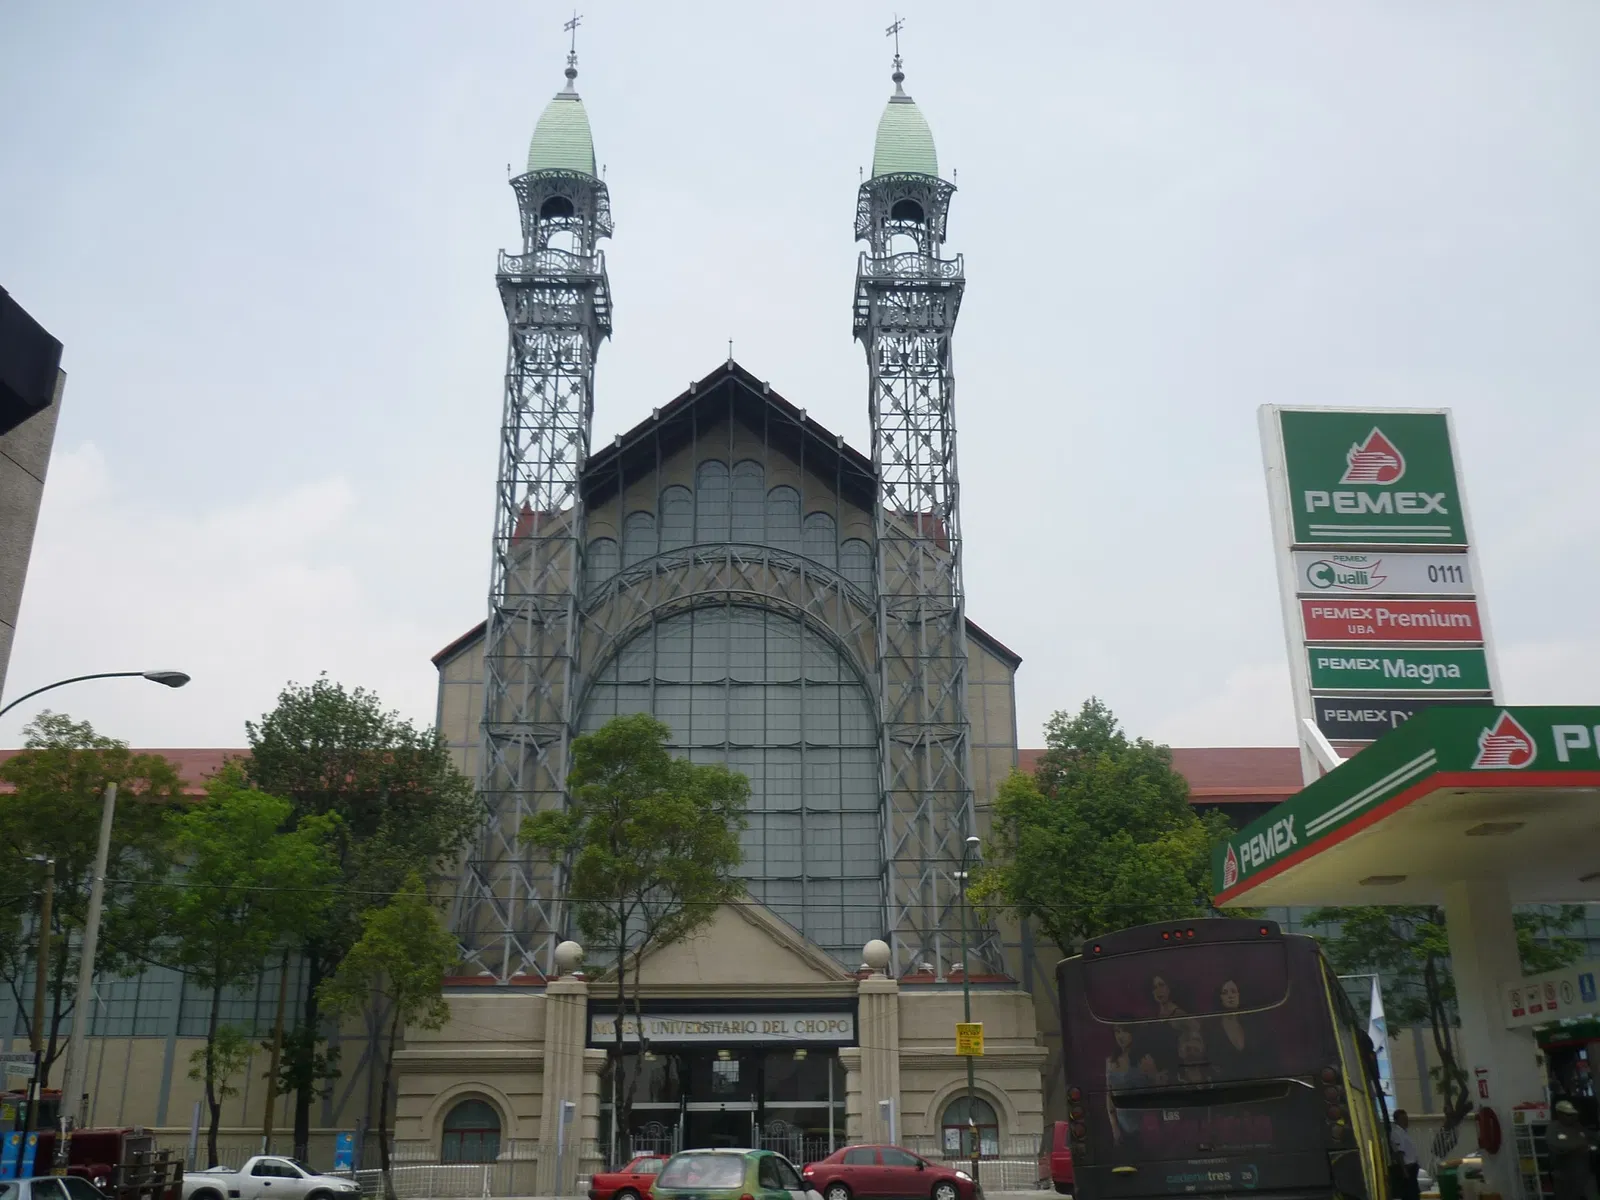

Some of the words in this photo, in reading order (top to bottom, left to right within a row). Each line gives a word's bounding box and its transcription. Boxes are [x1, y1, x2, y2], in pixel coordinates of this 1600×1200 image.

[1304, 490, 1448, 514] PEMEX
[1428, 565, 1464, 583] 0111
[1311, 608, 1373, 619] PEMEX
[1375, 608, 1472, 627] Premium
[1348, 625, 1375, 634] UBA
[1317, 658, 1380, 670] PEMEX
[1382, 659, 1461, 684] Magna
[1324, 709, 1388, 721] PEMEX
[1391, 710, 1413, 728] D
[1552, 724, 1600, 763] P
[1239, 814, 1298, 873] PEMEX
[650, 1020, 757, 1034] UNIVERSITARIO
[763, 1020, 788, 1034] DEL
[794, 1020, 849, 1034] CHOPO
